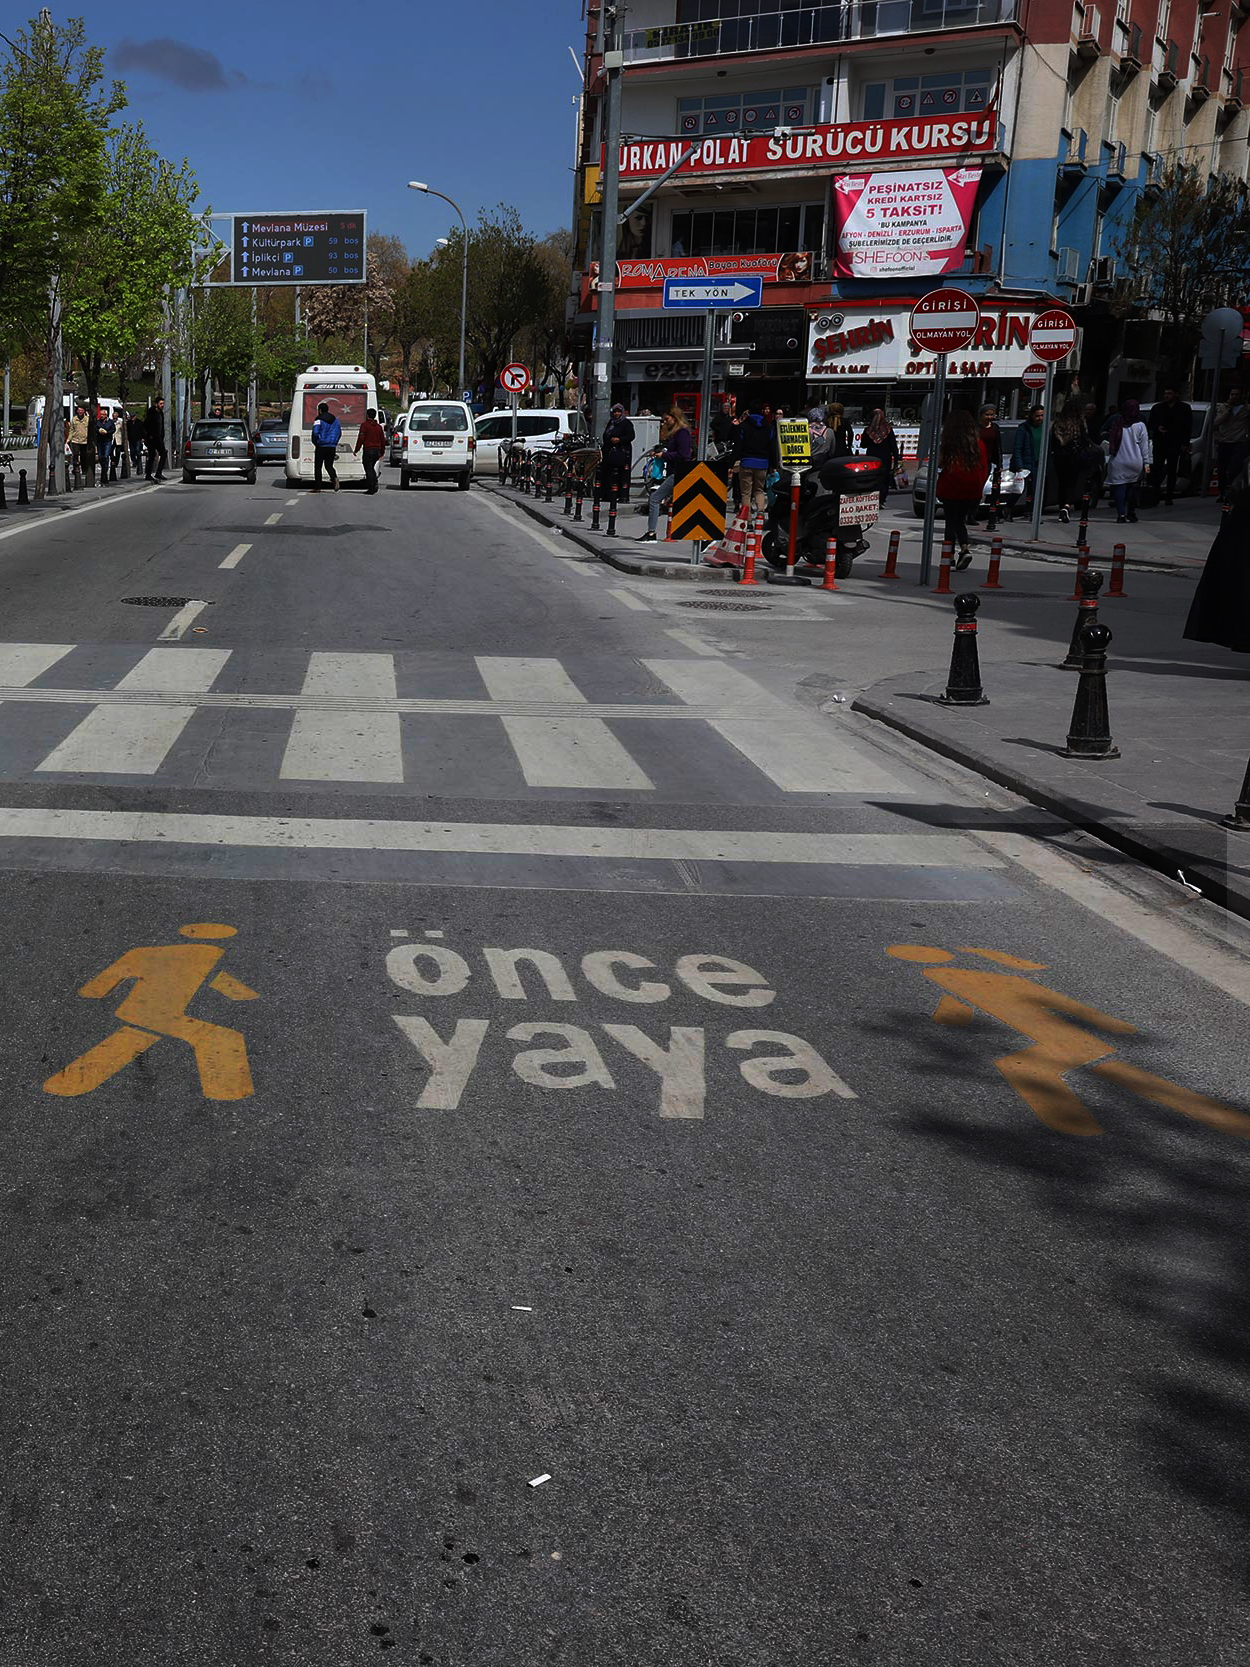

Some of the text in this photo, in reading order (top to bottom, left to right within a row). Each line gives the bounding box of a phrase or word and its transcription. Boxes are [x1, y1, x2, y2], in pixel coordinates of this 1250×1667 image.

[690, 139, 750, 166] POLAT
[890, 120, 990, 151] KURSU
[869, 181, 943, 195] PEŞİNATSIZ
[867, 194, 943, 205] KREDİ KARTSIZ
[866, 208, 875, 219] 5
[252, 224, 291, 233] Mevlana
[294, 222, 328, 232] Müzesi
[892, 220, 928, 228] KAMPANYA
[842, 231, 863, 239] AFYON
[898, 228, 931, 237] ERZURUM
[252, 238, 301, 249] Kültürpark
[329, 237, 338, 245] 59
[902, 237, 911, 245] DE
[252, 251, 280, 264] İplikçi
[328, 252, 338, 260] 93
[709, 258, 778, 270] Bayan Kuaförü
[252, 268, 291, 276] Mevlana
[675, 287, 729, 298] TEK YÖN
[922, 299, 967, 311] GİRİŞİ
[1037, 318, 1069, 329] GİRİŞİ
[814, 318, 894, 362] ŞEHRİN
[916, 330, 971, 339] OLMAYAN YOL
[645, 362, 700, 378] ezel
[848, 364, 870, 374] SAAT
[905, 358, 993, 375] OPTİ & SAAT
[780, 434, 809, 444] LAHMACUN
[787, 444, 805, 454] BÖREK
[841, 506, 854, 514] ALO
[840, 515, 854, 525] 0332
[385, 929, 777, 1008] önce
[390, 1014, 859, 1119] yaya
